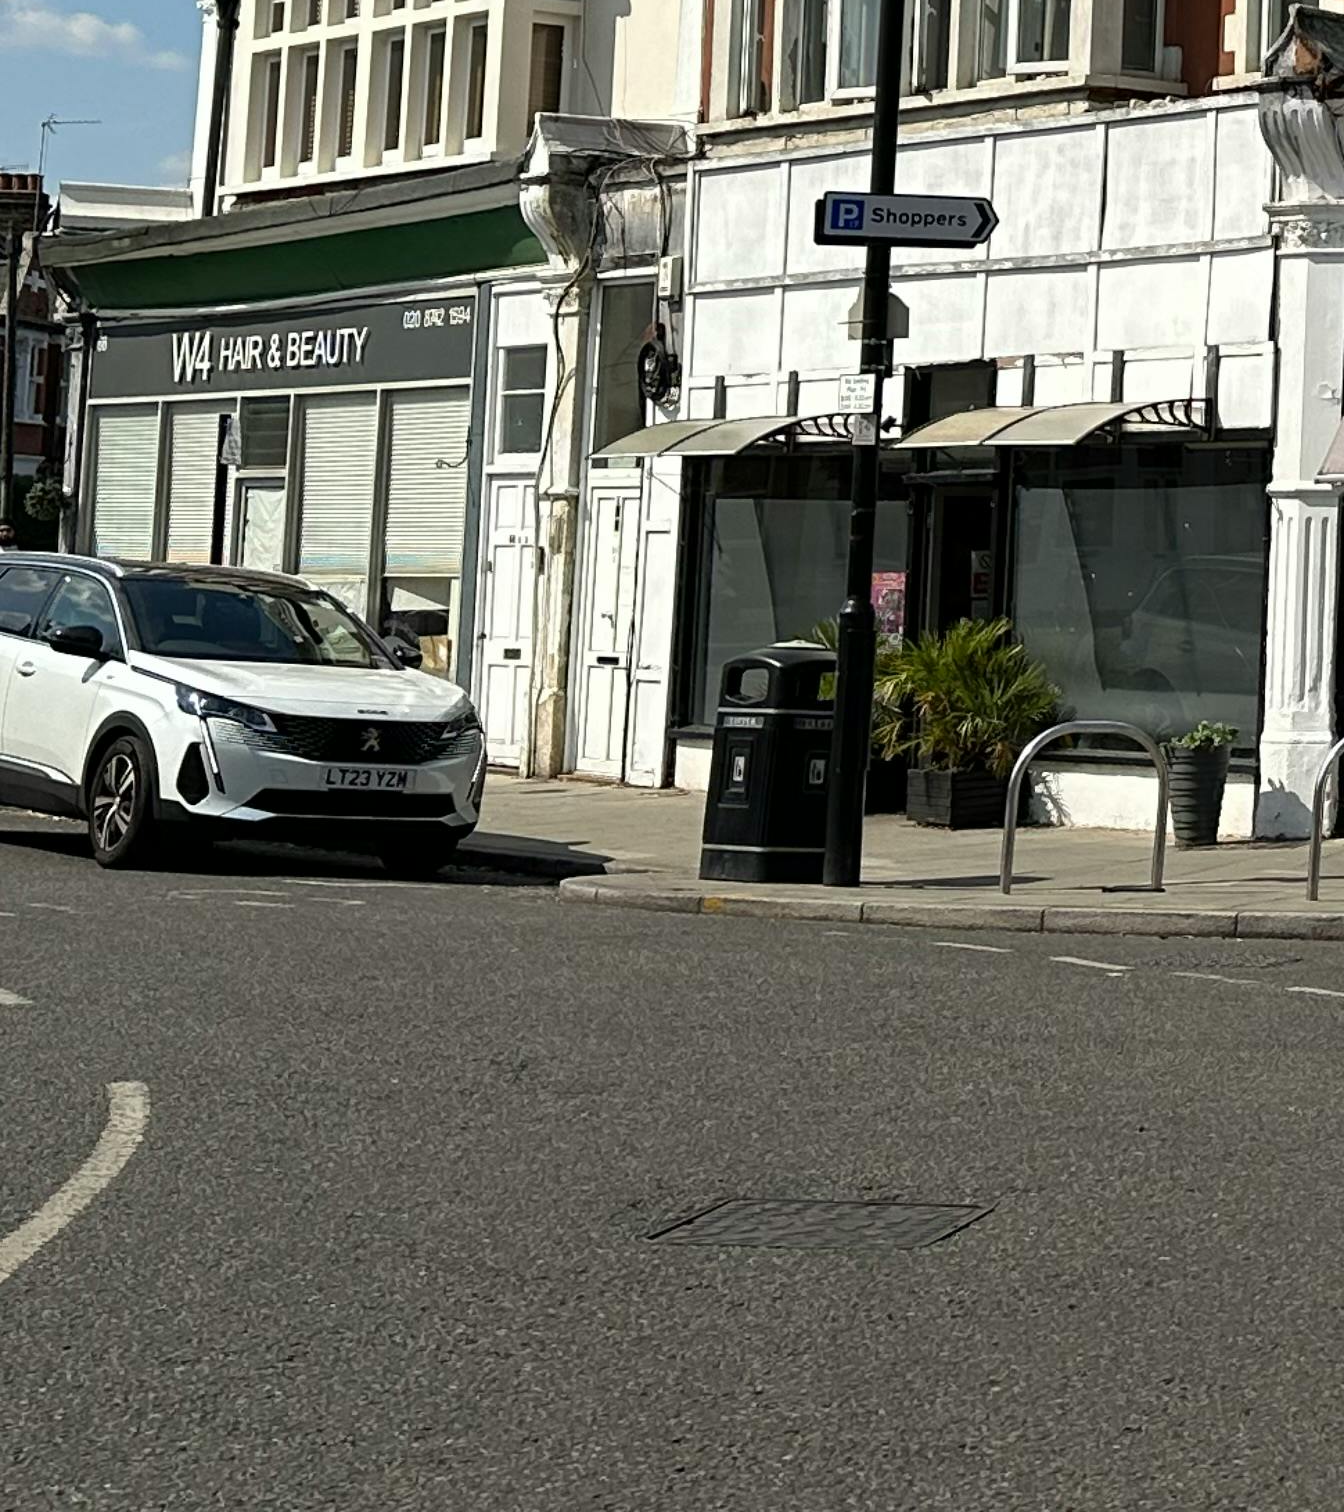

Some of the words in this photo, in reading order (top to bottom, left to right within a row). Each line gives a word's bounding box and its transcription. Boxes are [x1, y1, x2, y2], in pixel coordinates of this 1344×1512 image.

[838, 202, 859, 228] P
[871, 207, 968, 228] Shoppers
[172, 330, 213, 383] W4
[218, 335, 263, 371] HAIR
[267, 333, 281, 368] &
[286, 326, 369, 367] BEAUTY
[325, 768, 371, 787] LT23
